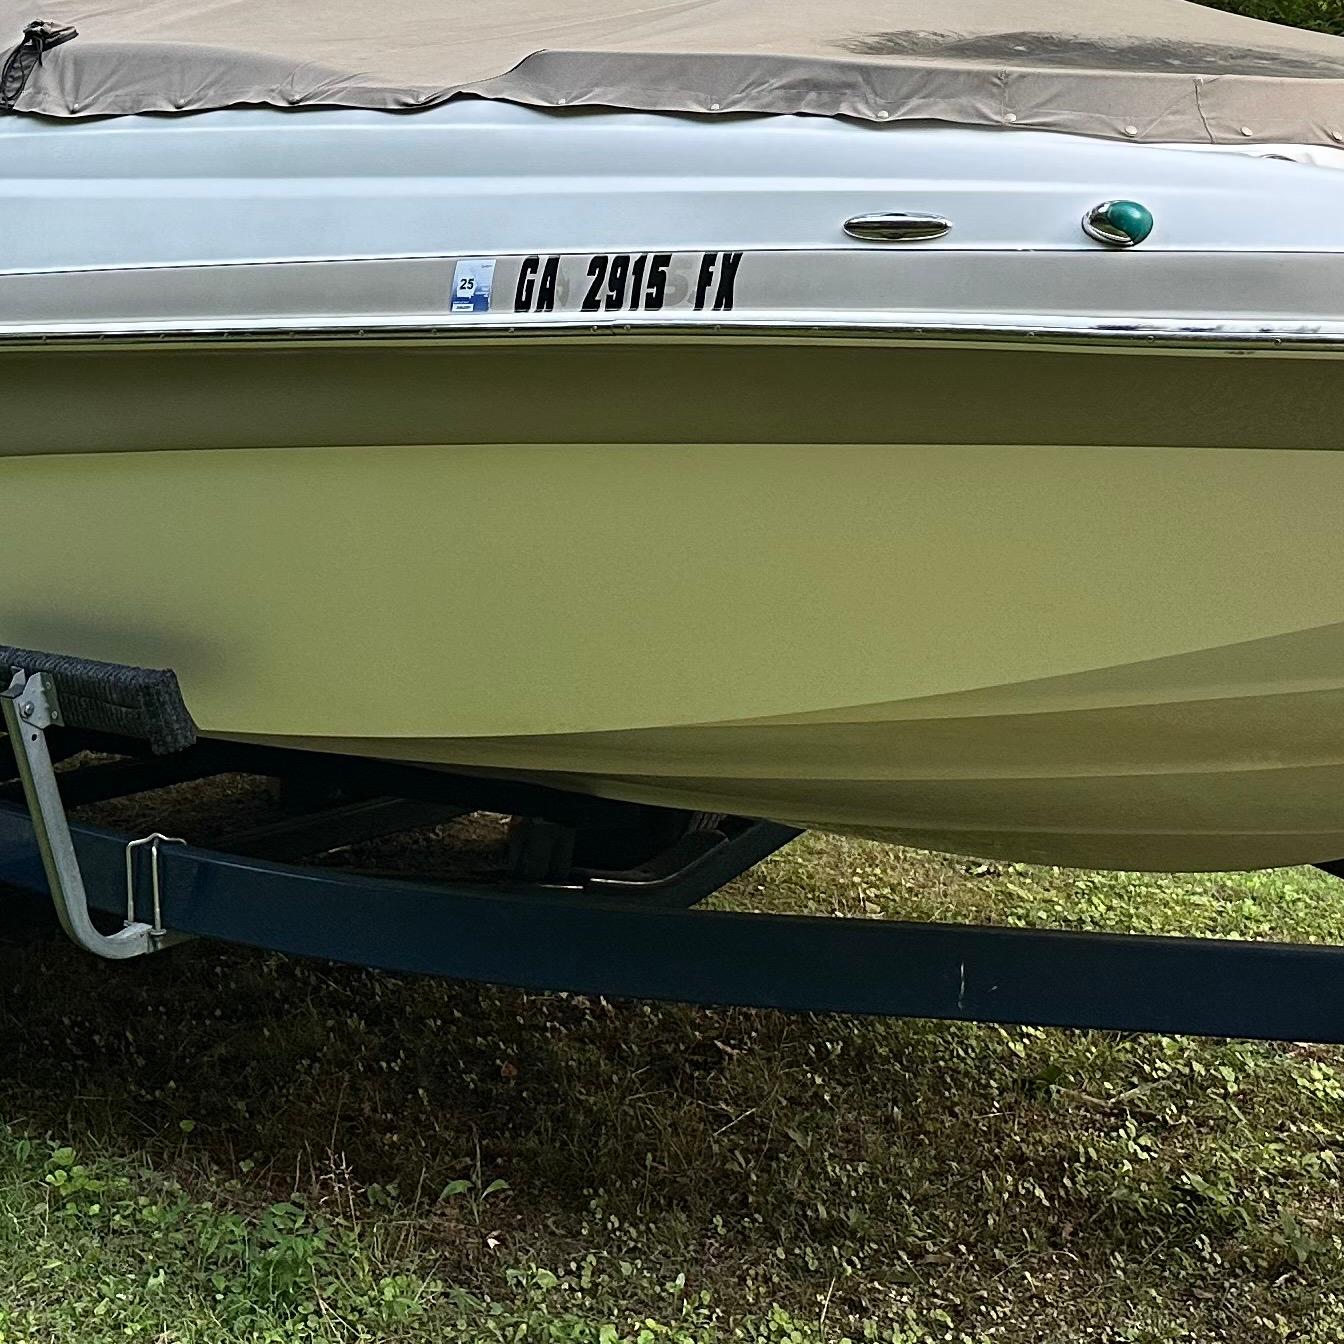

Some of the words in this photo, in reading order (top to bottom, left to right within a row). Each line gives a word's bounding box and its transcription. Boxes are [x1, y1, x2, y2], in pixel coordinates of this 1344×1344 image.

[459, 278, 474, 290] 25
[513, 255, 560, 311] GA
[580, 253, 673, 311] 2915
[693, 253, 744, 311] FX
